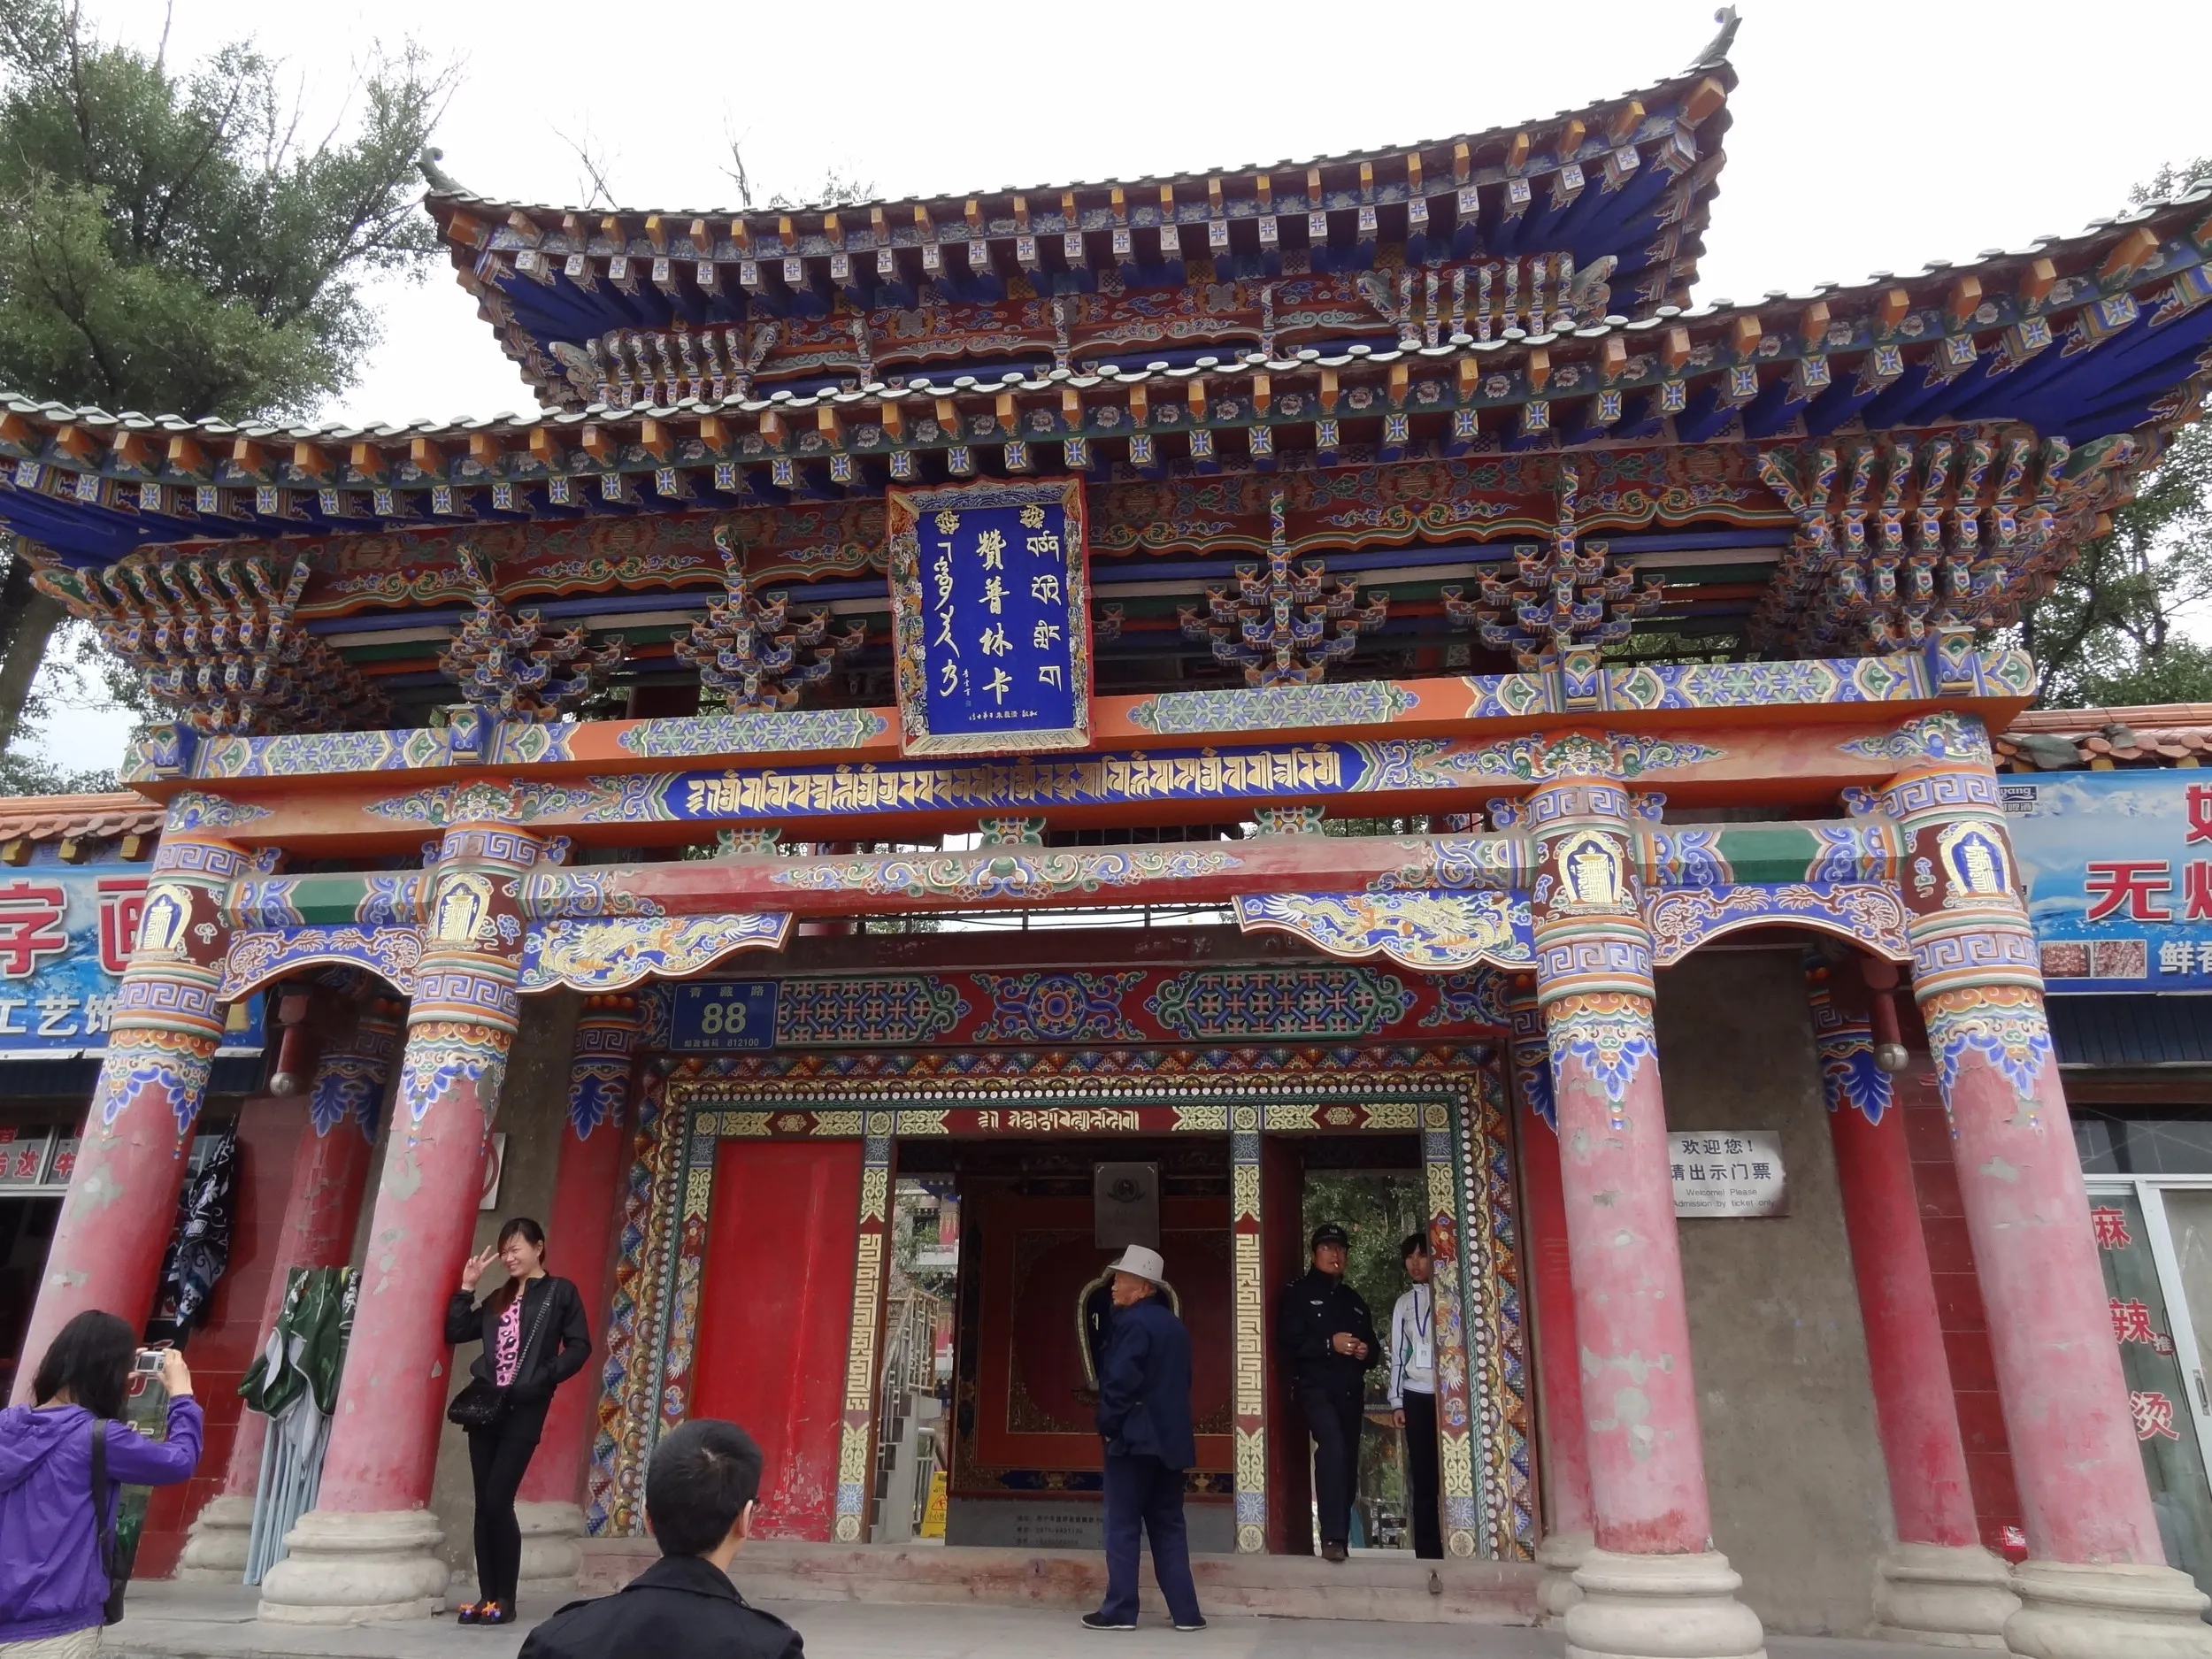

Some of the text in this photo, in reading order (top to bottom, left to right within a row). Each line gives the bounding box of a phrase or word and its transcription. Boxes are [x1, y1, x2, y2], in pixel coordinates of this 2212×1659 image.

[690, 986, 764, 998] 青藏路
[702, 1002, 747, 1033] 88
[727, 1038, 759, 1047] 812100
[1671, 1162, 1771, 1180] 请出示门票
[1717, 1200, 1726, 1209] by
[2154, 1334, 2173, 1354] 推
